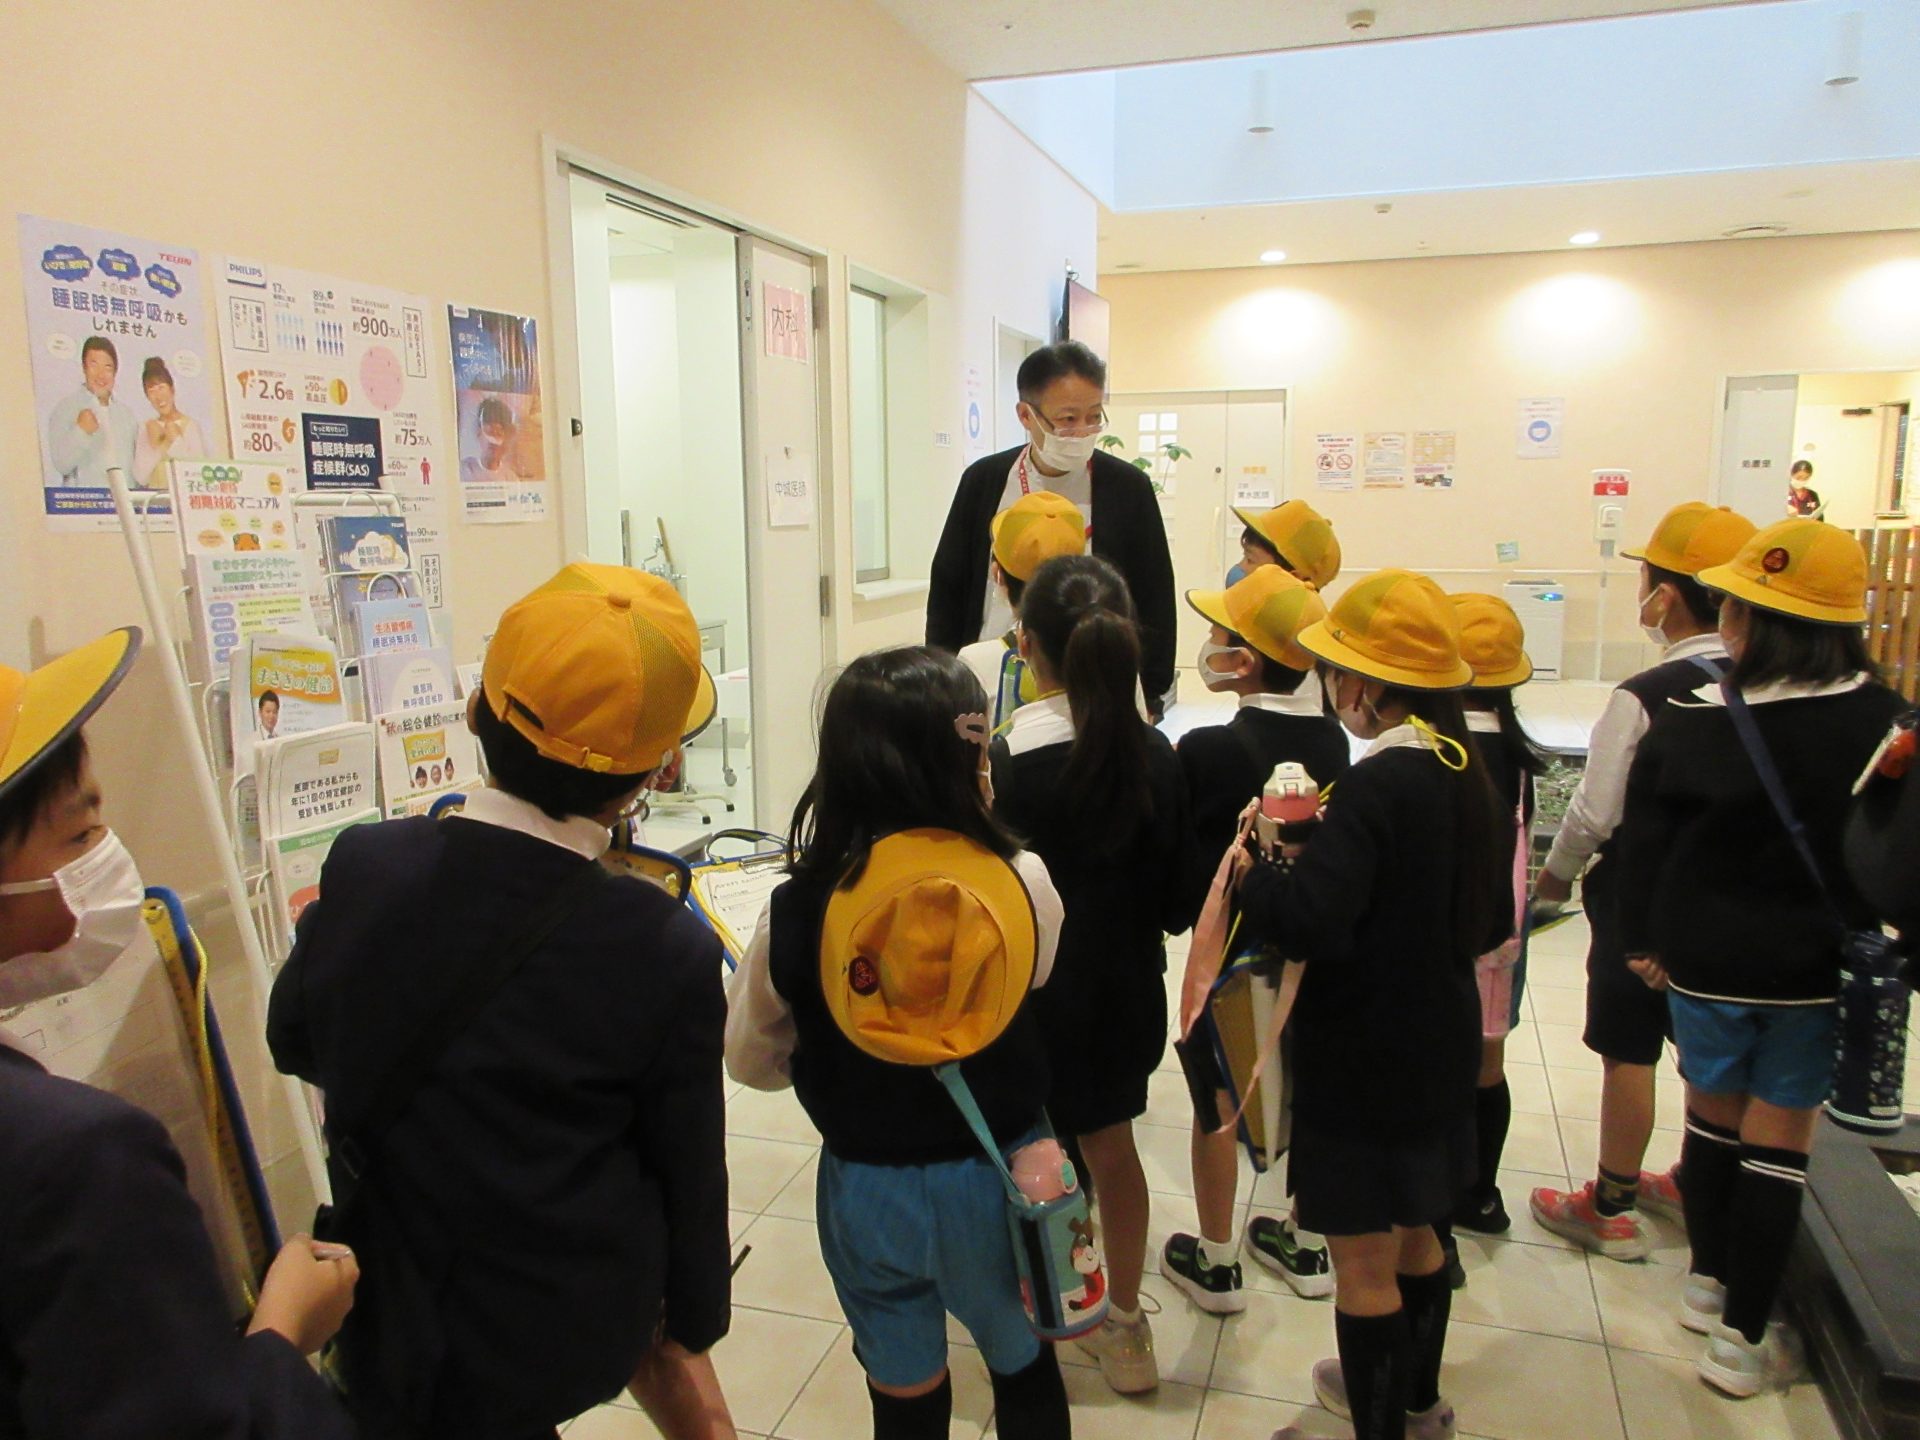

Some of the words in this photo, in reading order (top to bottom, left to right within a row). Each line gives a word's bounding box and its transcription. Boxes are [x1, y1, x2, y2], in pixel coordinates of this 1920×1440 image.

[159, 252, 192, 266] TEIJIN
[229, 263, 263, 278] PHILIPS
[52, 287, 188, 326] 睡眠時無呼吸かも
[92, 316, 158, 338] しれません
[353, 316, 402, 338] 約900万人
[771, 304, 800, 336] 内科
[258, 379, 295, 400] 2.6倍
[395, 428, 433, 446] 約75万人
[311, 441, 376, 458] 睡眠時無呼吸
[313, 460, 370, 477] 症候群(SAS)
